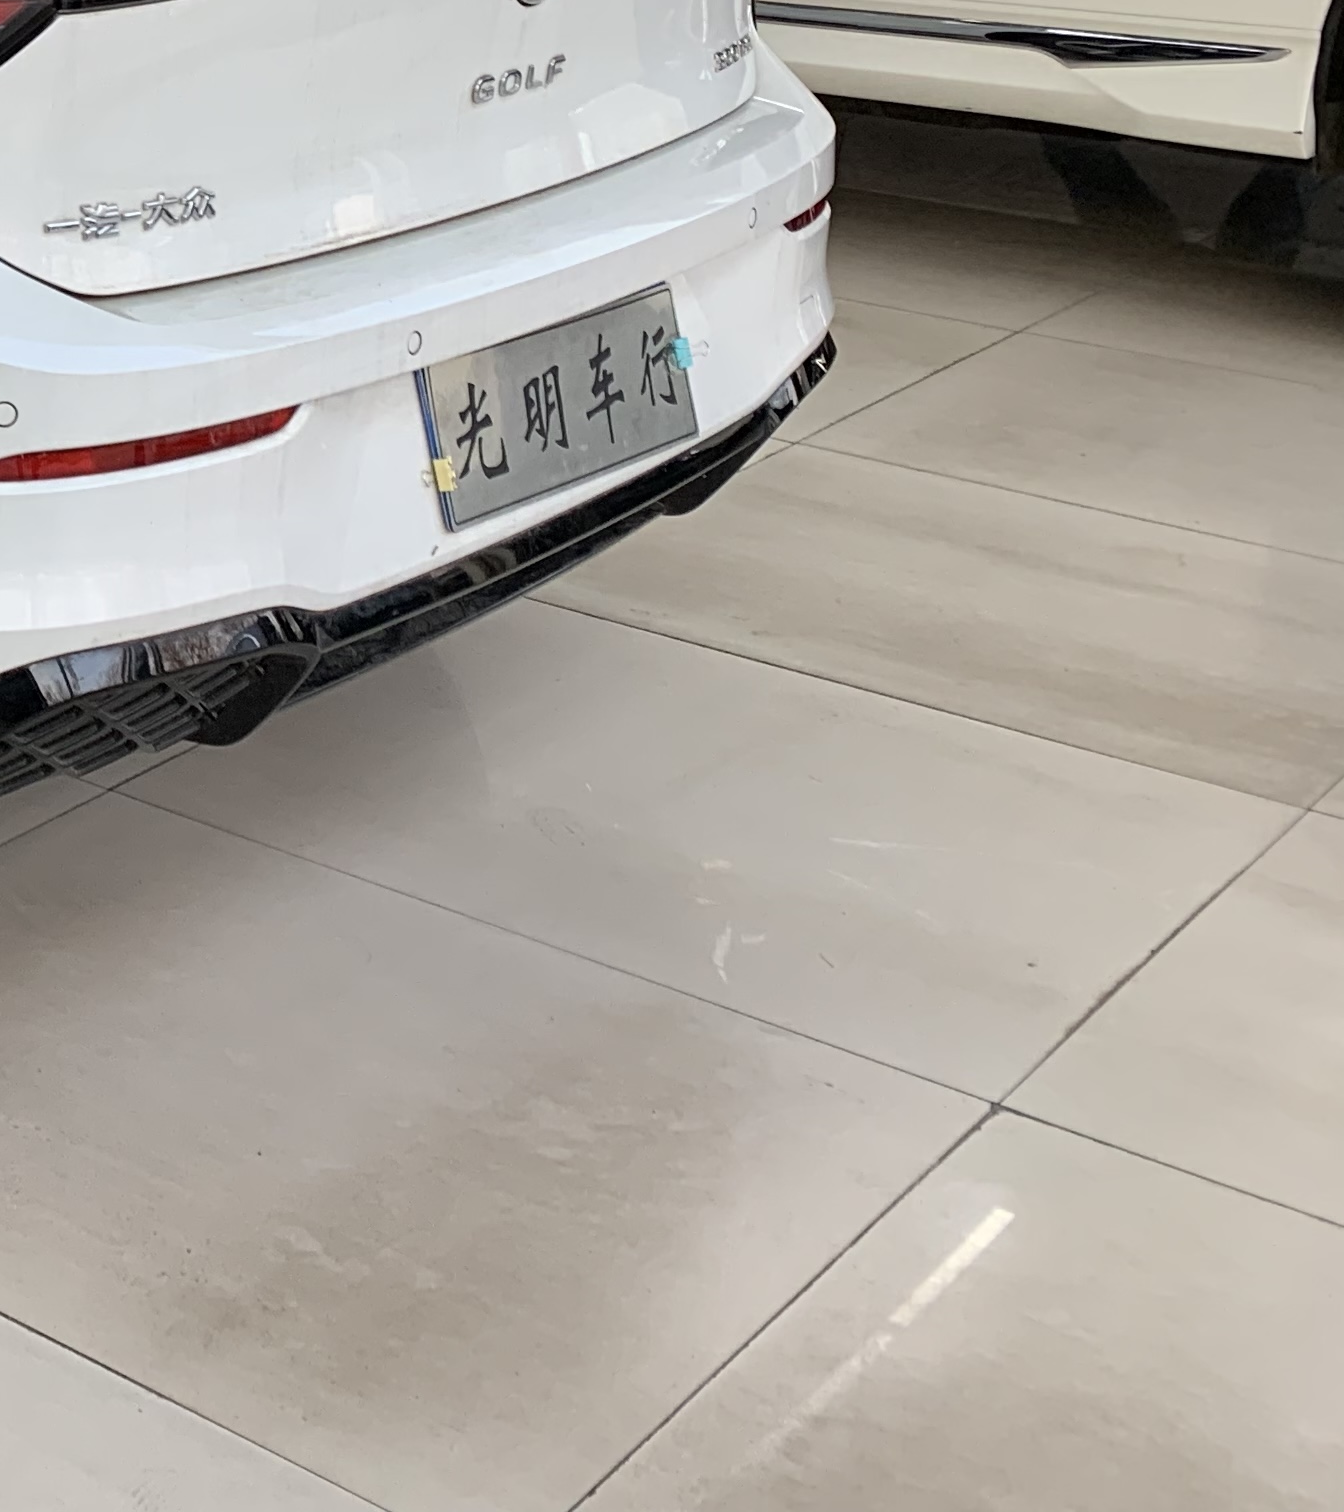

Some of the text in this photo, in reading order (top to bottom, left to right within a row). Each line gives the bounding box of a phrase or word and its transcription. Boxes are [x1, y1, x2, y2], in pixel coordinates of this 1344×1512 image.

[471, 53, 567, 105] GOLF
[456, 325, 678, 481] 光明车行
